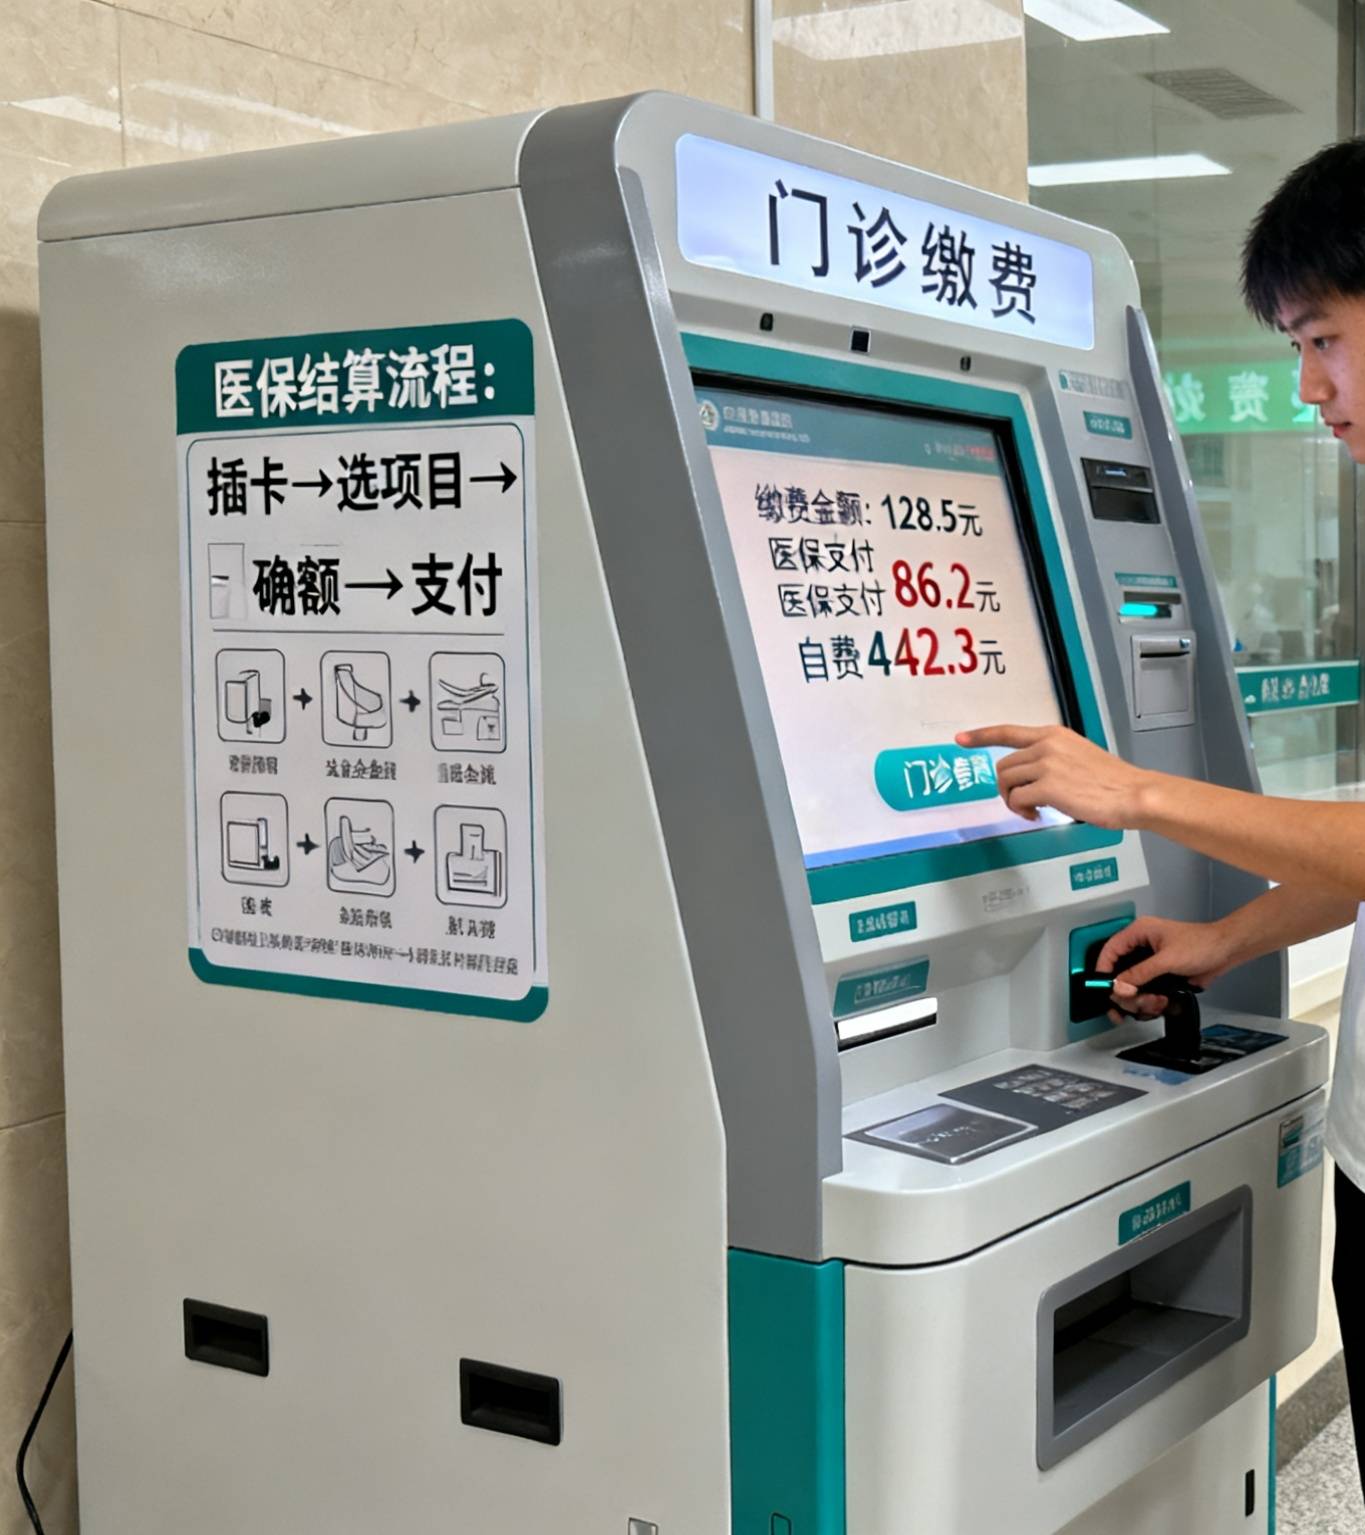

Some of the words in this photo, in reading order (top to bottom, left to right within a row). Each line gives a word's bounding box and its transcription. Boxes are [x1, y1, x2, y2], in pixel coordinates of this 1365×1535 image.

[768, 179, 1037, 325] 门诊缴费
[214, 344, 496, 419] 医保结算流程：
[206, 455, 289, 516] 插卡
[336, 451, 463, 513] 选项目
[411, 551, 503, 617] 支付
[768, 536, 875, 573] 医保支付
